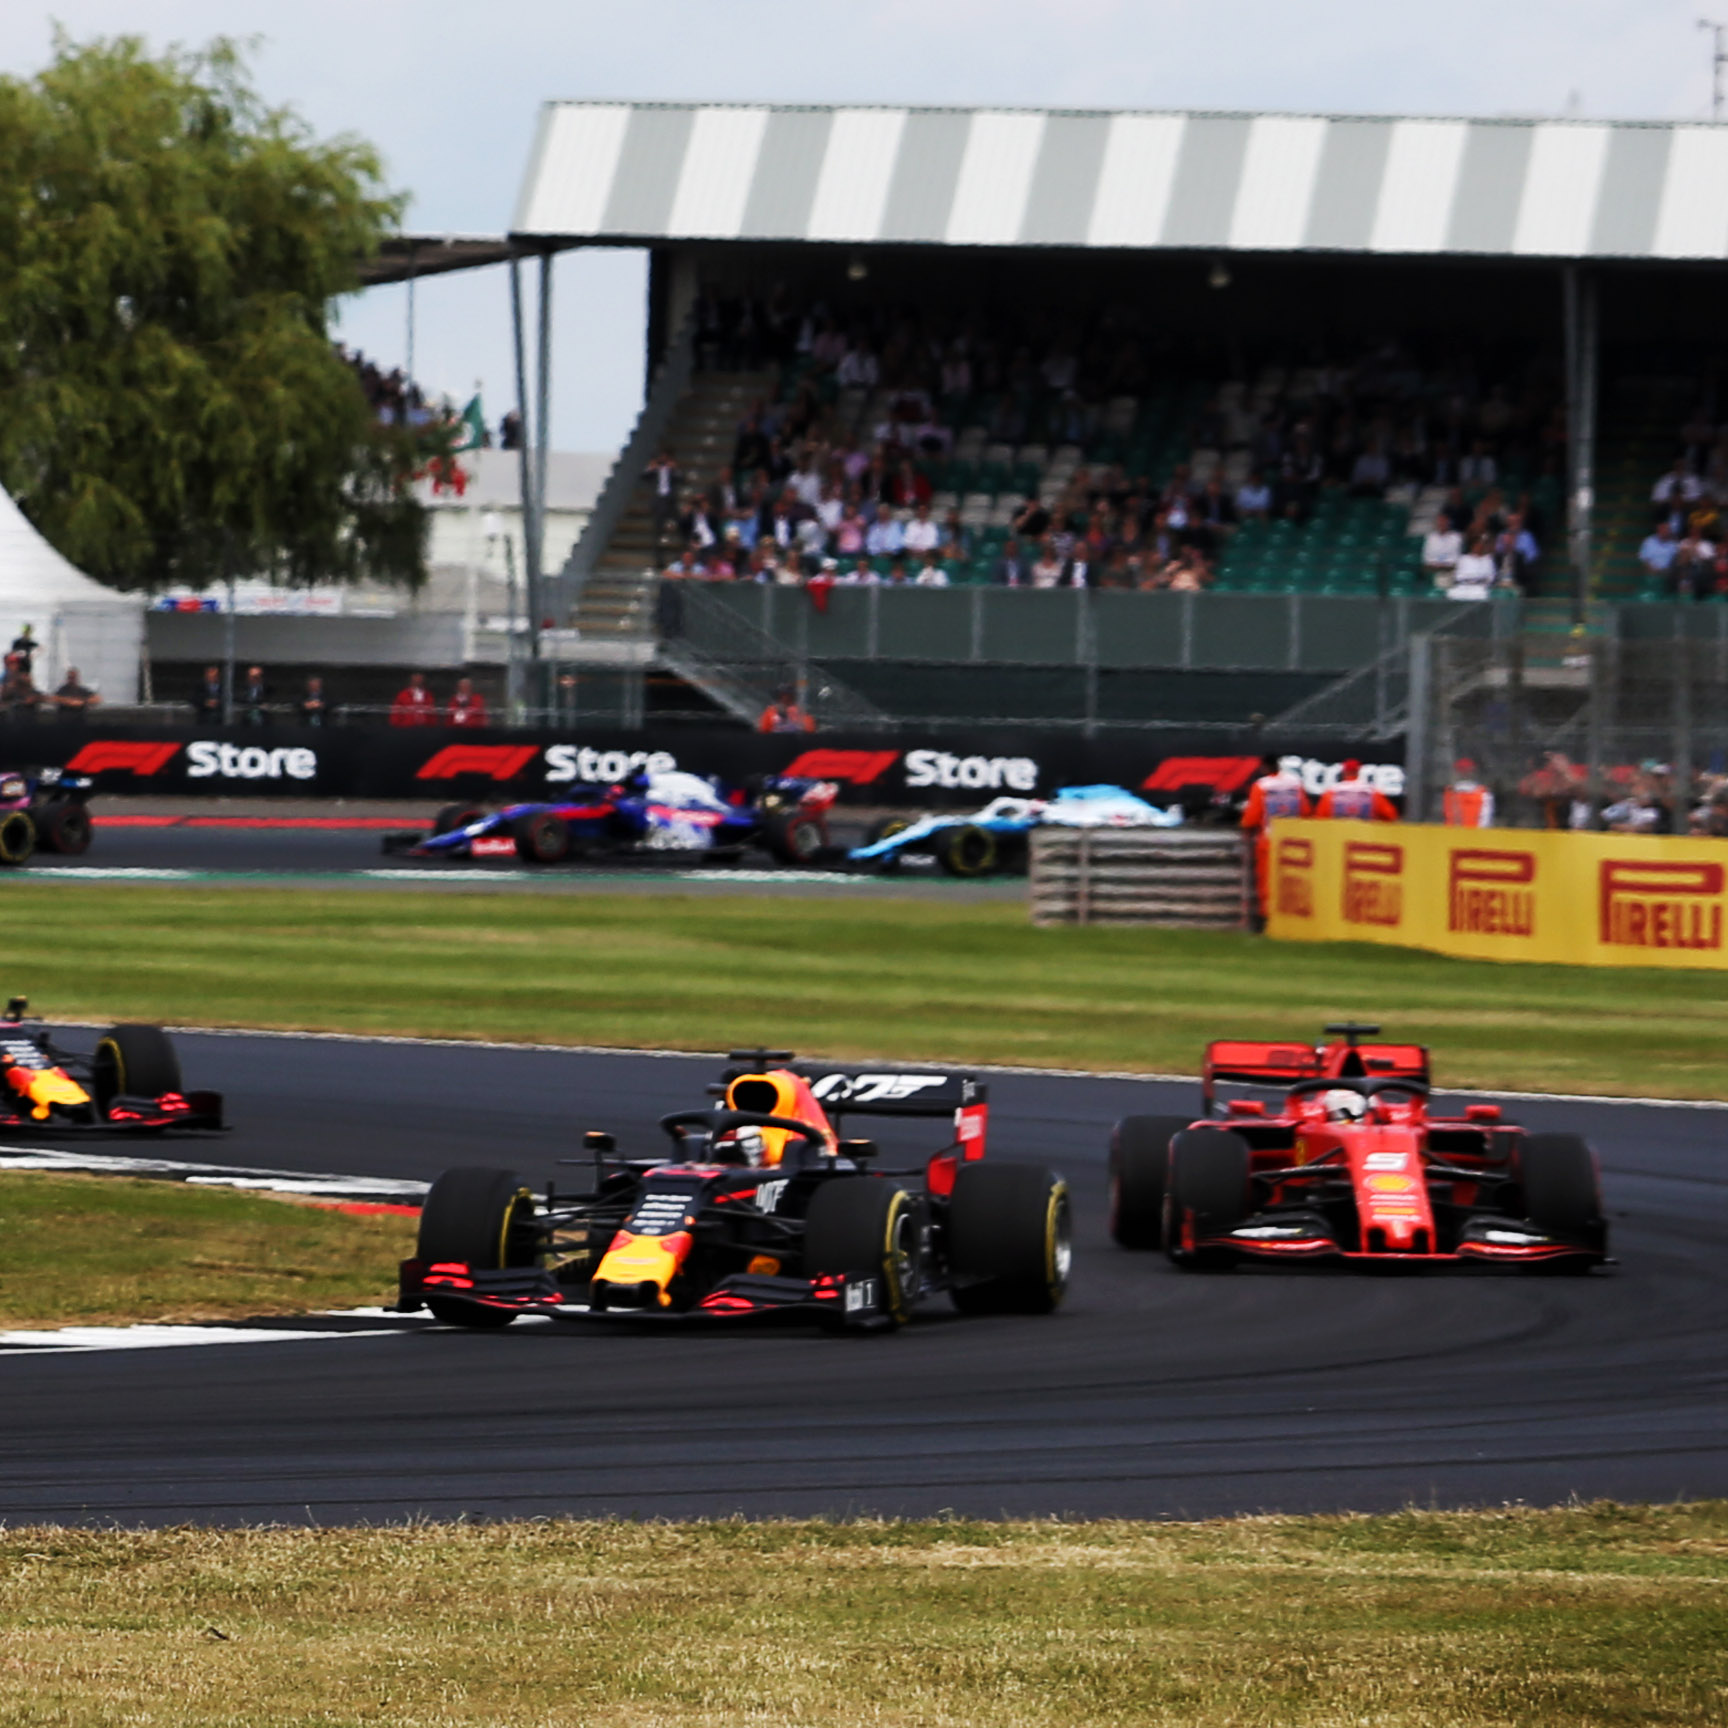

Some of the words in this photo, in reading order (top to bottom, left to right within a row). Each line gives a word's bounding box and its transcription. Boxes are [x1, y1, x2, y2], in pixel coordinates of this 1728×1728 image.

[187, 741, 317, 779] Store
[906, 750, 1038, 790] Store
[1449, 849, 1536, 937] PIRELLI
[1599, 860, 1724, 949] PIRELLI
